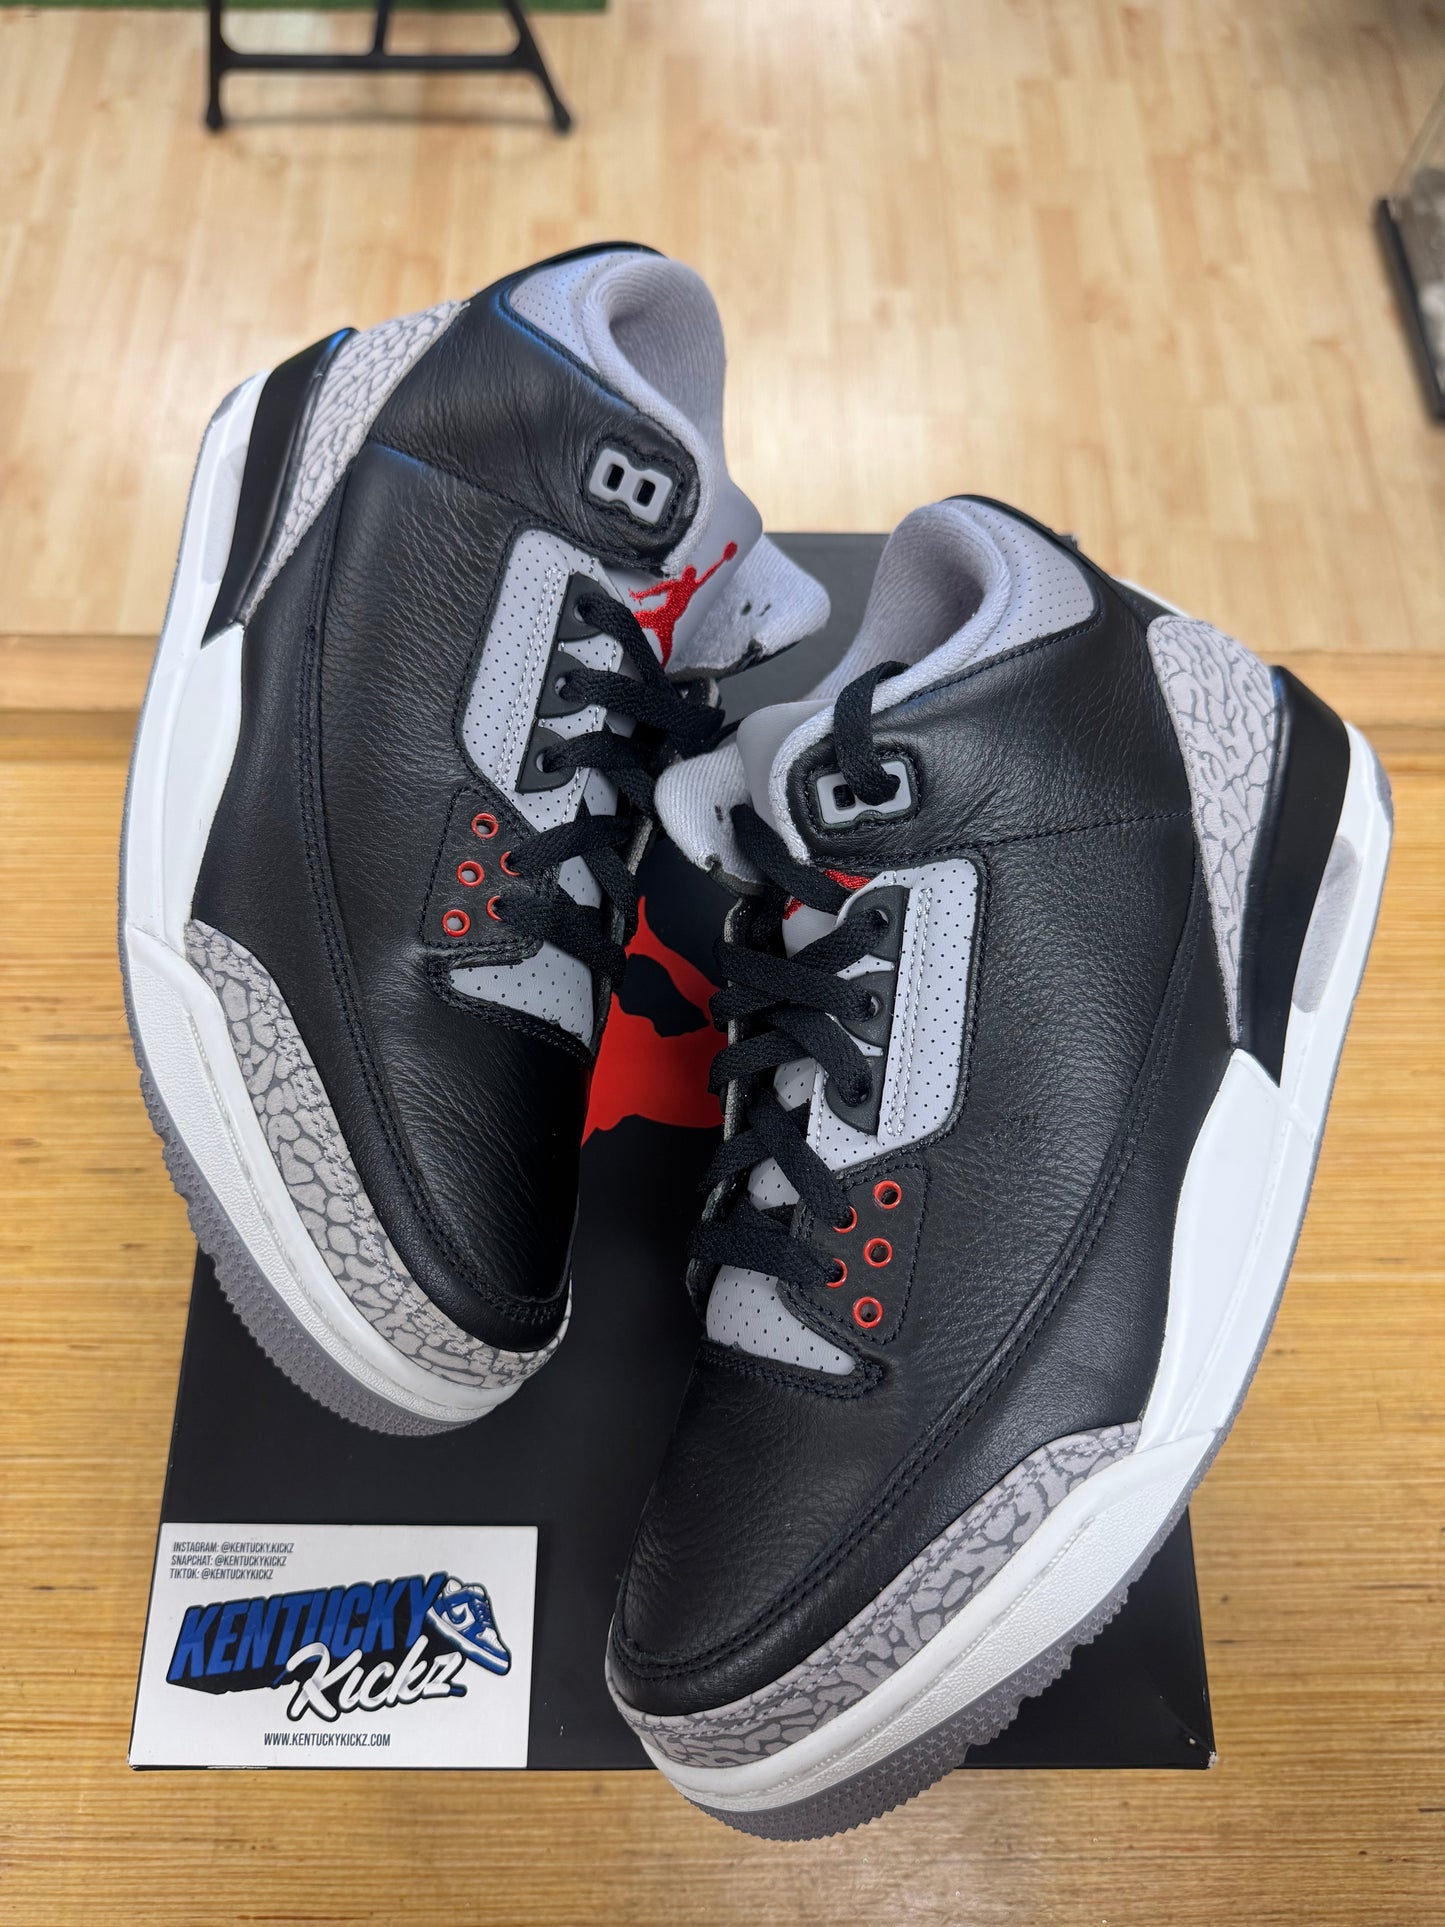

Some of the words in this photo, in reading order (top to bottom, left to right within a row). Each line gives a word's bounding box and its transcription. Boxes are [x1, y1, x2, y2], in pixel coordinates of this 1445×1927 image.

[173, 1541, 219, 1553] INSTAGRAM:
[221, 1541, 294, 1554] @KENTUCKY.KICKZ
[171, 1554, 213, 1566] SNAPCHAT:
[215, 1554, 287, 1567] @KENTUCKYKICKZ
[170, 1567, 200, 1579] TIKTOK:
[201, 1567, 274, 1580] @KENTUCKYKICKZ
[168, 1573, 448, 1683] KENTUCKY
[286, 1634, 463, 1720] Kickz
[263, 1732, 391, 1747] WWW.KENTUCKYKICKZ.COM
